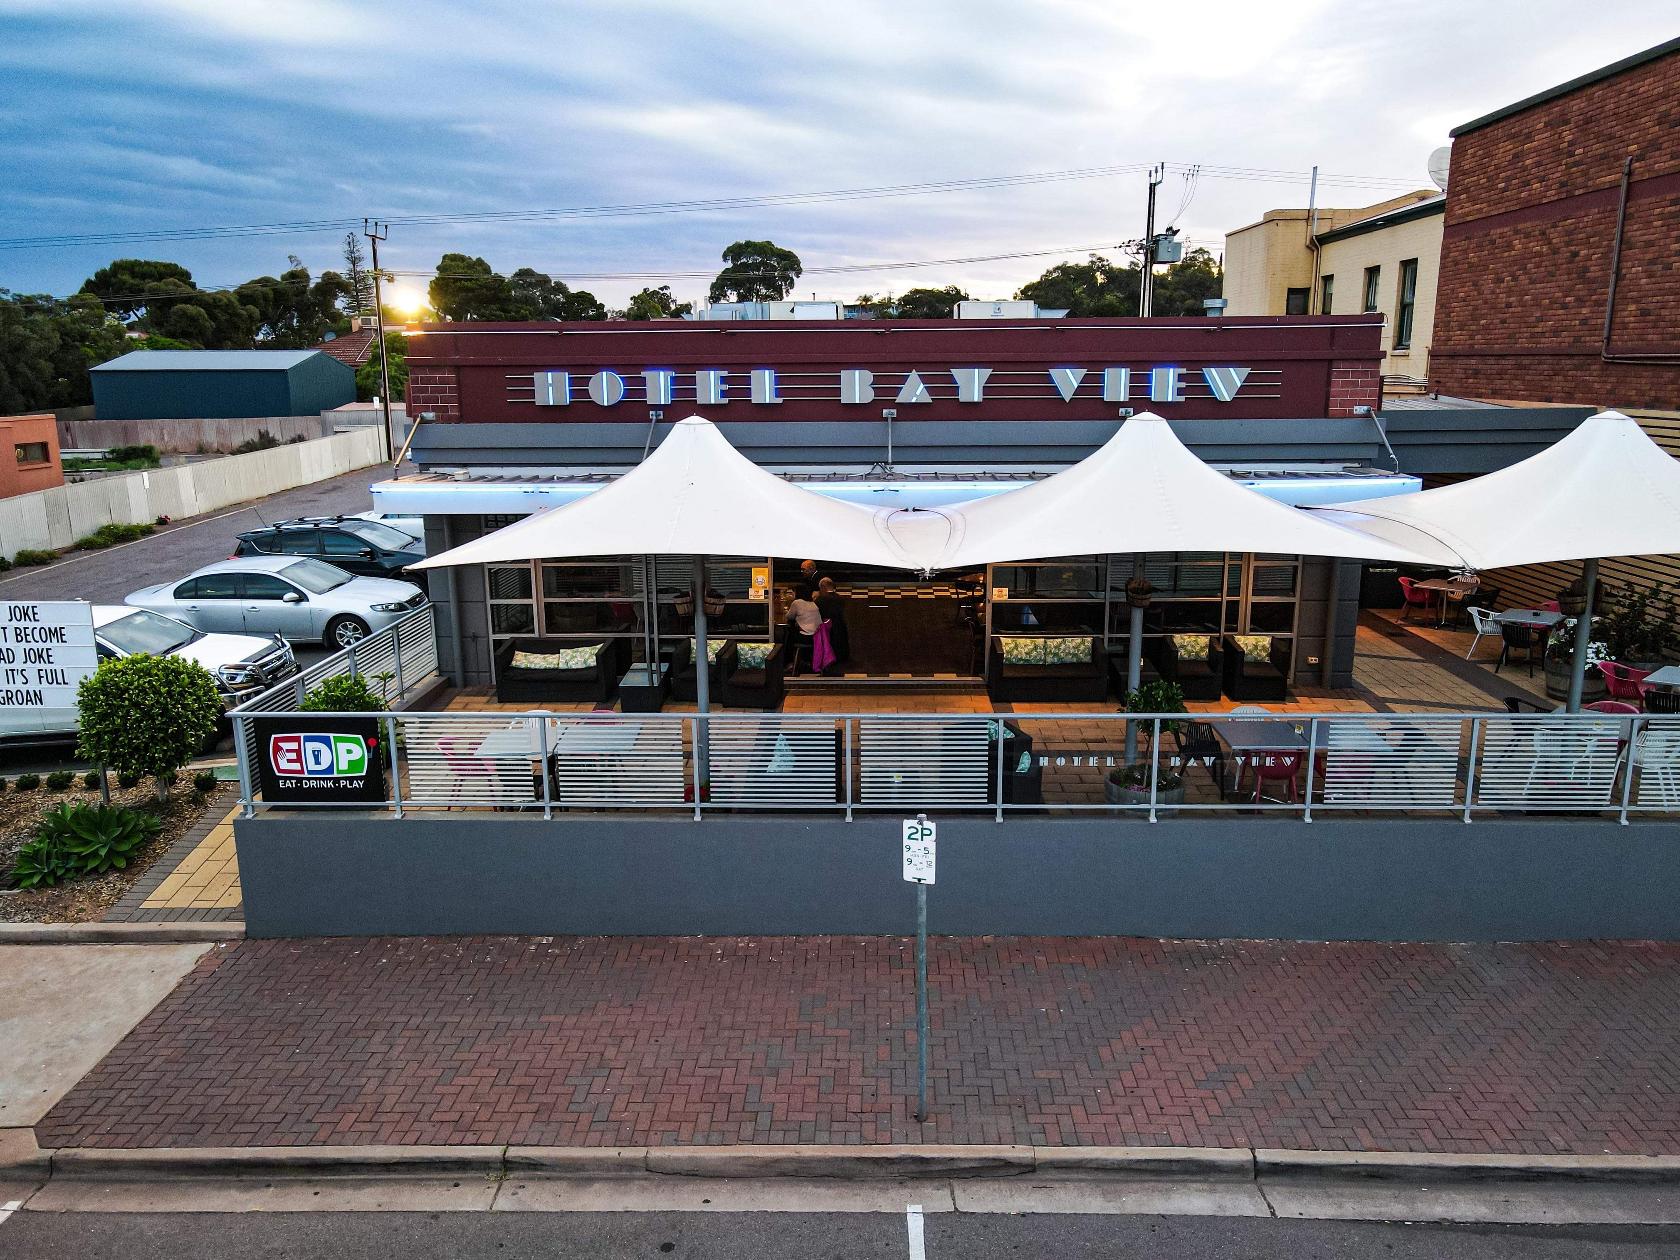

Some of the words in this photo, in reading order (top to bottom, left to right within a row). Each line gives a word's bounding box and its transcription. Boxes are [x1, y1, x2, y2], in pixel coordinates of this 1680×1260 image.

[534, 370, 783, 406] HOTEL
[840, 368, 994, 404] BAY
[1048, 367, 1252, 402] VIEW
[8, 605, 40, 622] JOKE
[14, 626, 67, 643] BECOME
[23, 648, 54, 664] JOKE
[5, 669, 28, 685] IT'S
[37, 669, 69, 685] FULL
[277, 741, 363, 771] EDP
[1039, 756, 1116, 767] HOTEL
[1170, 756, 1216, 767] BAY
[1235, 756, 1295, 767] VIEW
[279, 780, 296, 788] EAT
[302, 780, 334, 788] DRINK
[340, 780, 364, 788] PLAY
[907, 826, 933, 841] 2P
